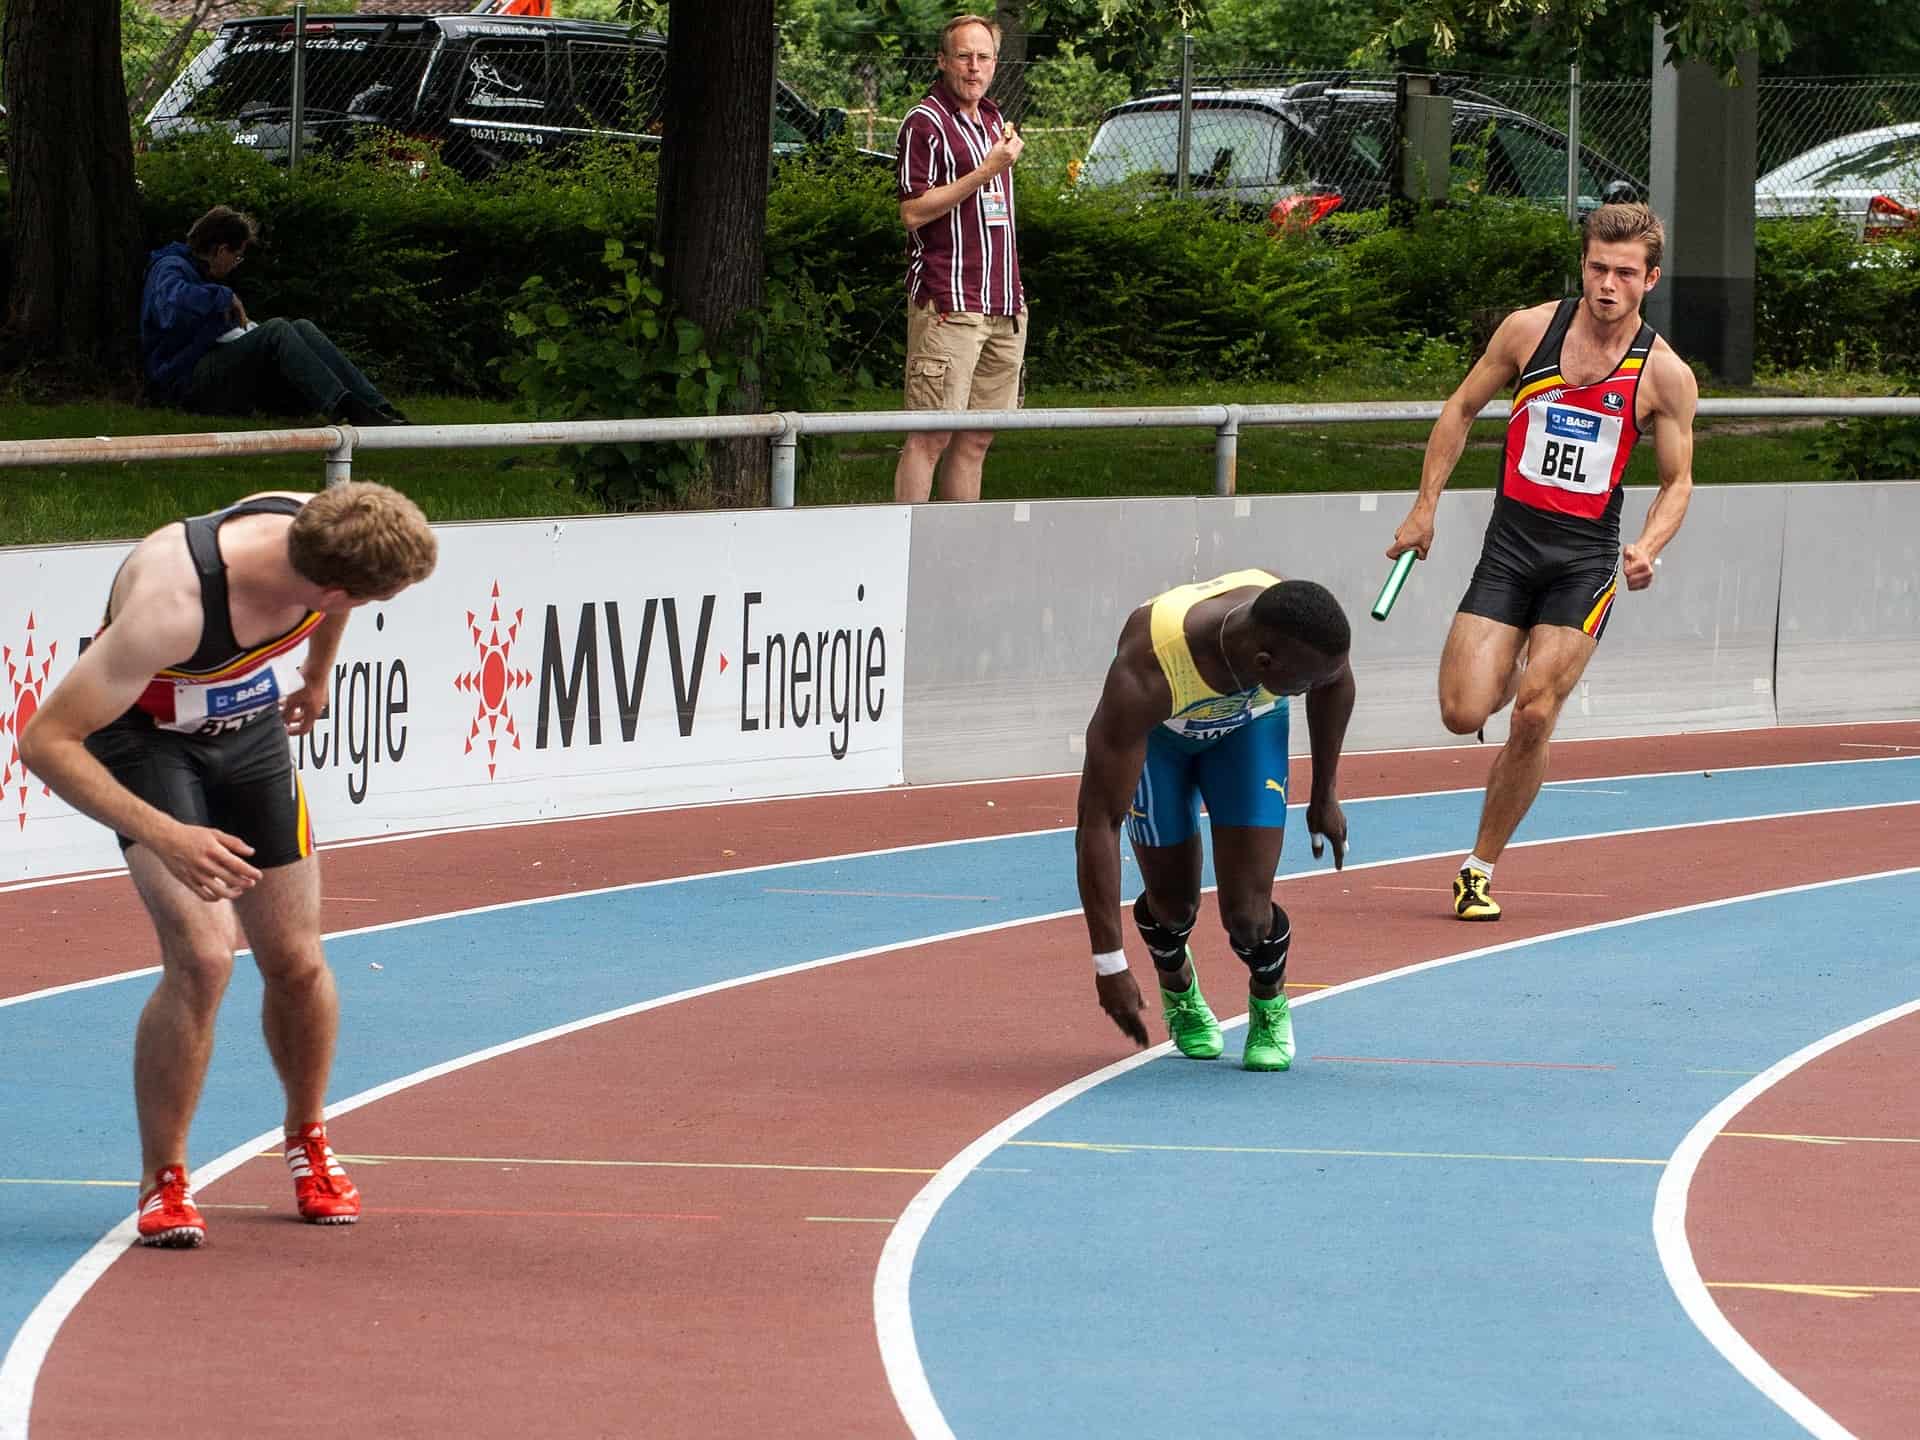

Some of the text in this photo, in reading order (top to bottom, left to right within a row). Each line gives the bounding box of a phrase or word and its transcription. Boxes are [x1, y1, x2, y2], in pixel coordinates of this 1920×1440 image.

[232, 37, 368, 54] www.guch.de
[1566, 416, 1595, 429] BASF
[1541, 440, 1587, 483] BEL
[535, 583, 886, 760] MVV Energie
[235, 679, 273, 702] BASF
[298, 612, 408, 805] ergie
